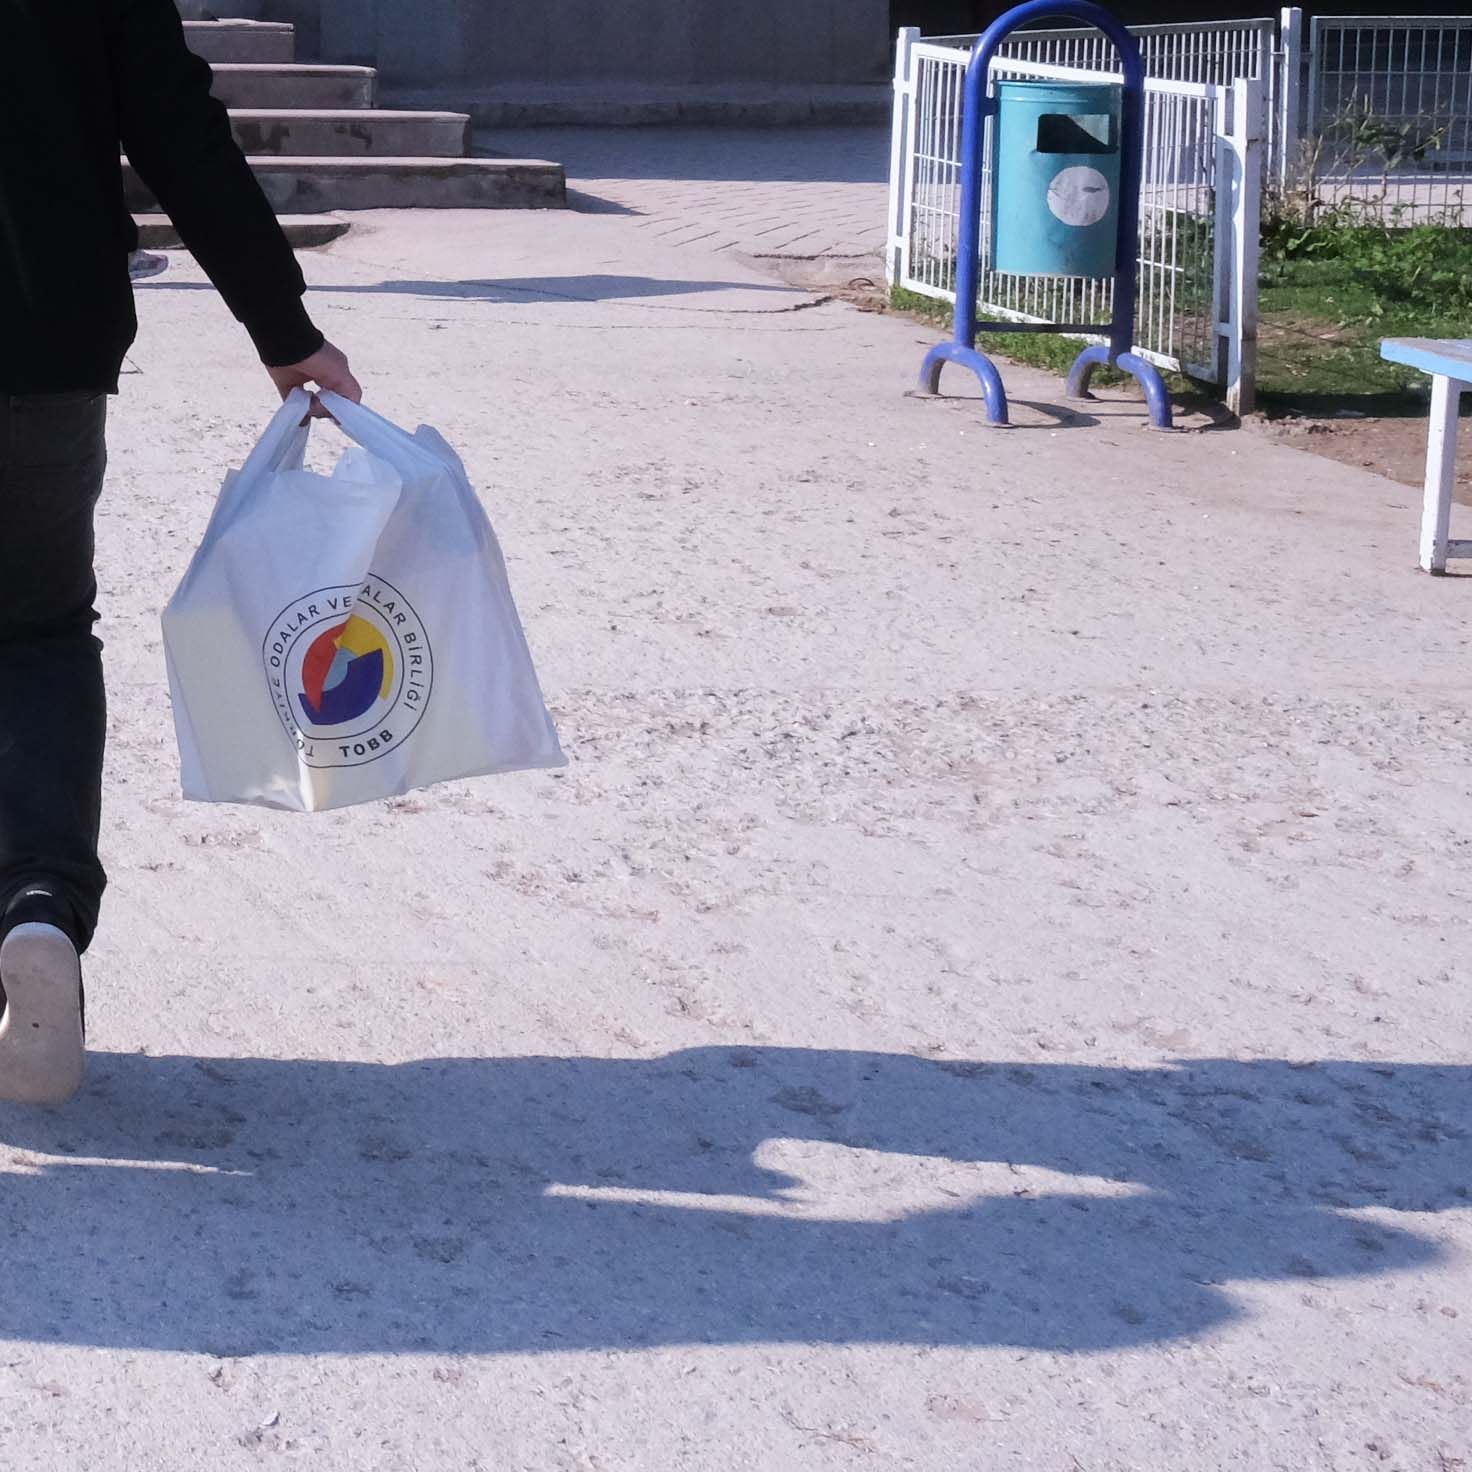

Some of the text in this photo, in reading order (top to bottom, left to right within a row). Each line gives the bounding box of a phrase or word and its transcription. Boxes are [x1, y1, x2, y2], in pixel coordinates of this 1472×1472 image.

[270, 604, 320, 667] ODALAR
[328, 595, 352, 610] VE
[404, 632, 425, 712] BİRLİĞİ
[339, 729, 394, 758] TOBB
